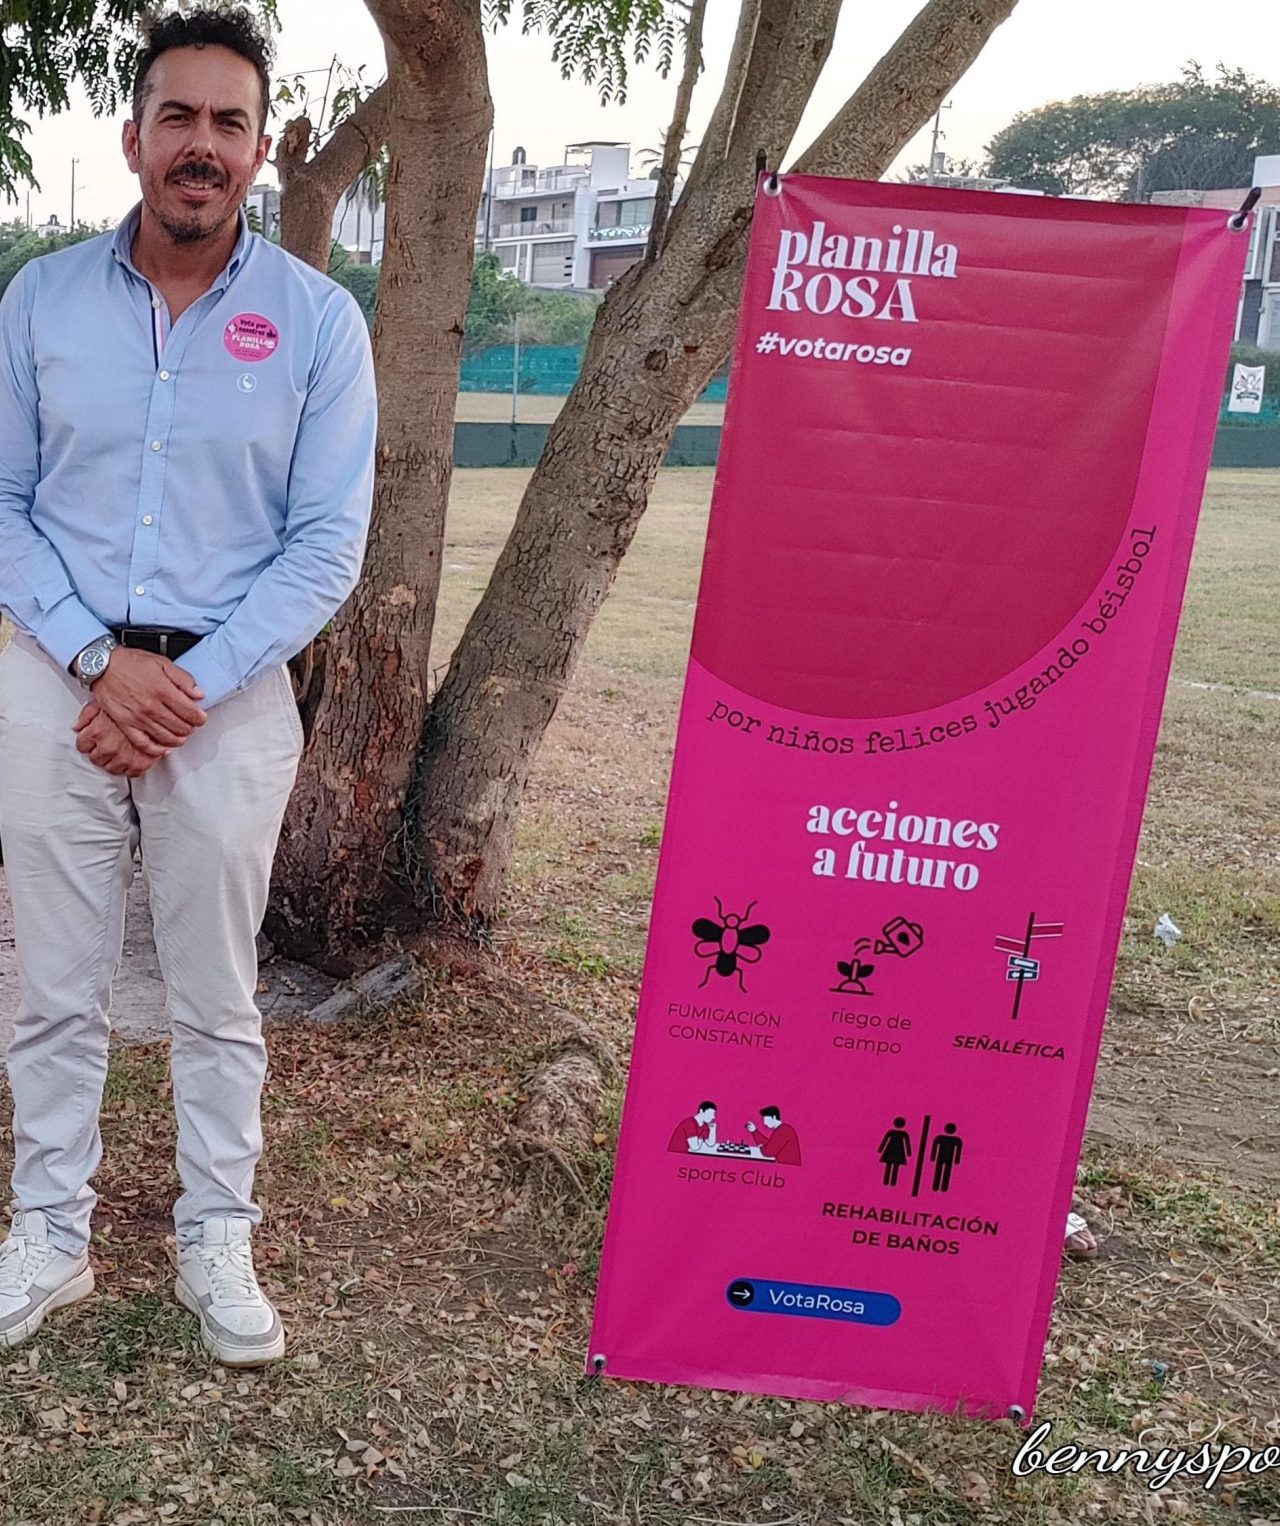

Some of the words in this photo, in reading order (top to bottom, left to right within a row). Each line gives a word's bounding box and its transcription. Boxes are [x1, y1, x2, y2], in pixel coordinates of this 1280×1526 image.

[776, 221, 959, 279] planilla
[765, 266, 919, 323] ROSA
[240, 318, 255, 327] Vota
[239, 342, 260, 350] ROSA
[755, 331, 912, 367] #votarosa
[706, 699, 761, 734] por
[766, 721, 855, 756] niños
[863, 711, 978, 756] felices
[983, 636, 1090, 730] jugando
[1082, 523, 1157, 636] béisbol
[806, 800, 1000, 852] acciones
[812, 847, 836, 878] a
[844, 840, 980, 892] futuro
[668, 1003, 781, 1029] FUMIGACIÓN
[830, 1007, 880, 1031] riego
[886, 1013, 912, 1030] de
[669, 1025, 774, 1050] CONSTANTE
[833, 1035, 902, 1056] campo
[952, 1033, 1066, 1060] SEÑALÉTICA
[677, 1164, 736, 1186] sports
[742, 1169, 786, 1189] Club
[822, 1202, 999, 1236] REHABILITACIÓN
[852, 1230, 880, 1247] DE
[886, 1233, 960, 1256] BAÑOS
[769, 1289, 865, 1316] VotaRosa
